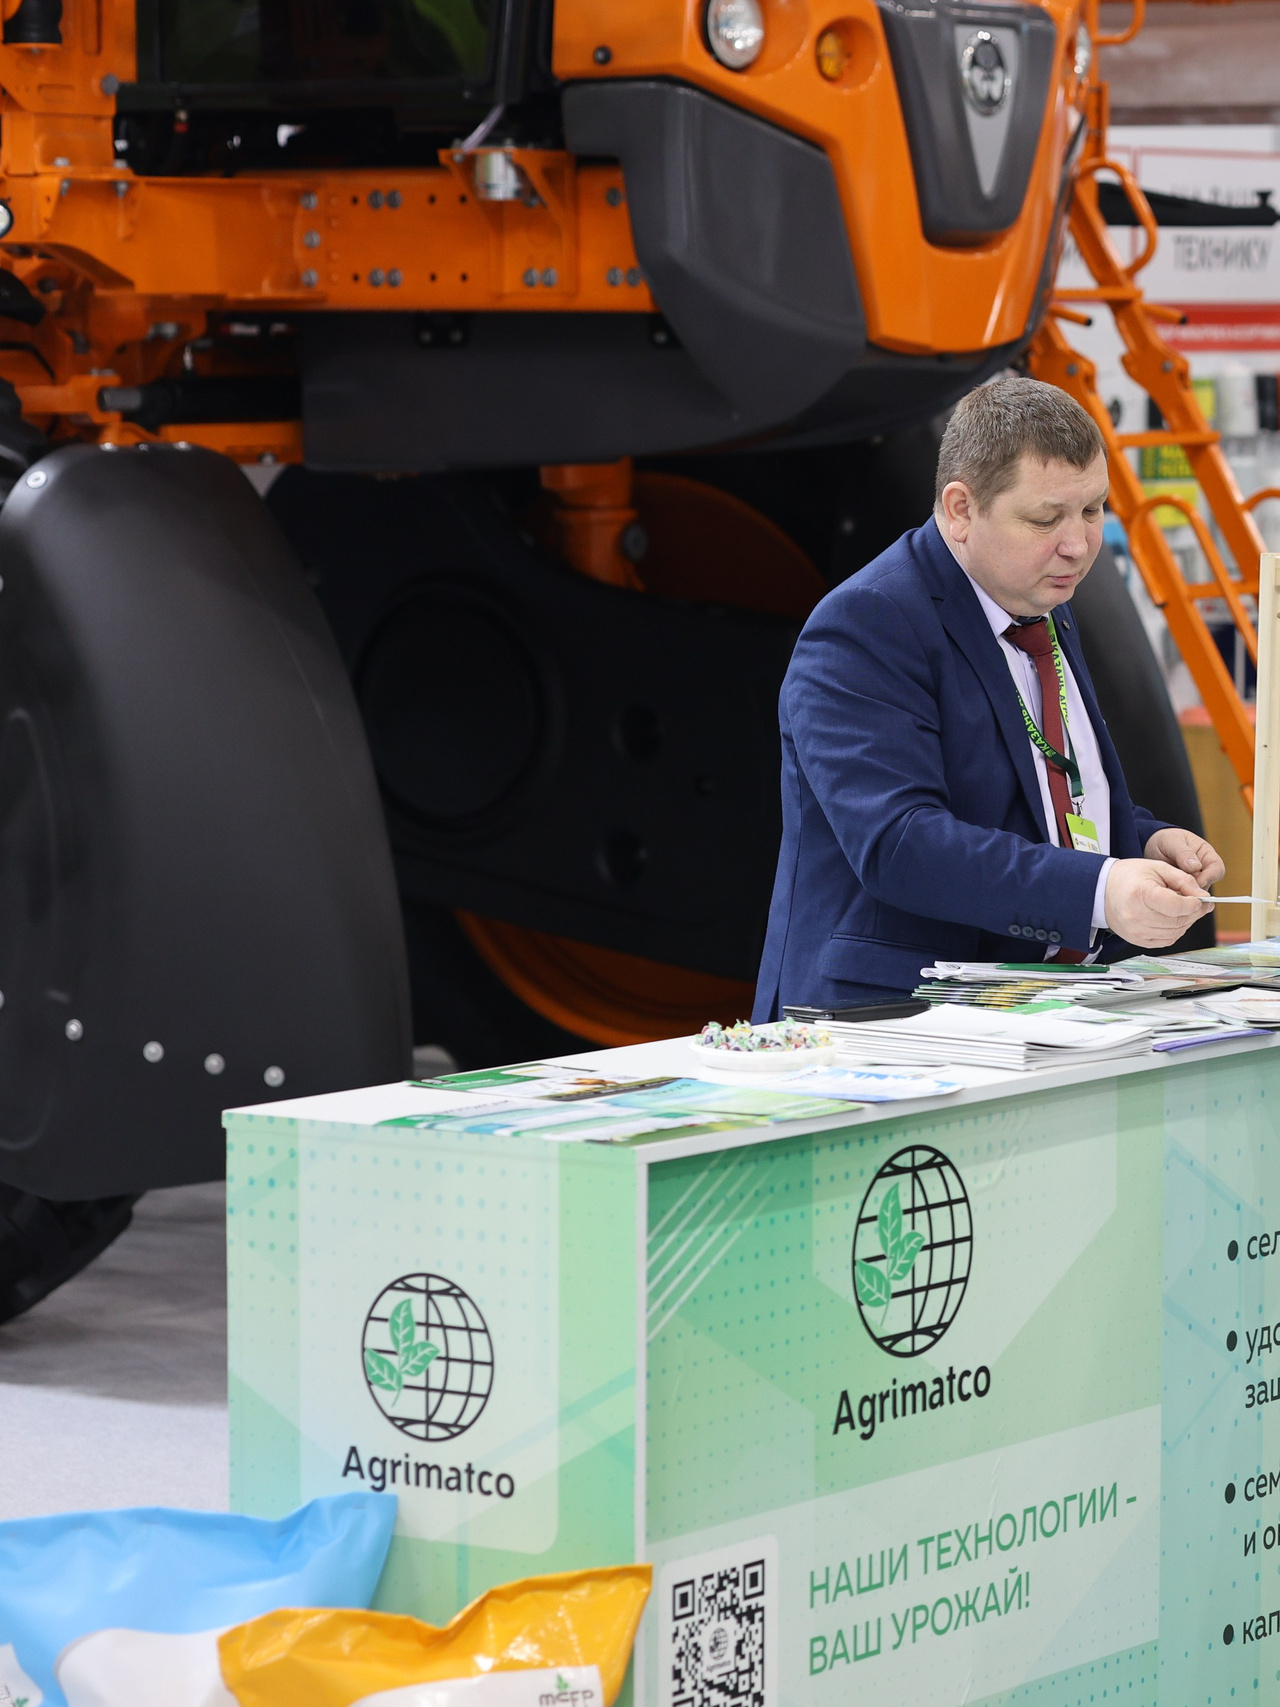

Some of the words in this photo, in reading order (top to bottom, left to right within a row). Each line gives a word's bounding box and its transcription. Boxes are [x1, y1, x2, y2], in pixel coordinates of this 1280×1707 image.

[1173, 233, 1274, 272] ТЕХНИКУ
[832, 1365, 991, 1441] Agrimatco
[342, 1446, 515, 1499] Agrimatco
[808, 1543, 909, 1609] НАШИ
[917, 1481, 1119, 1576] ТЕХНОЛОГИИ
[1245, 1531, 1256, 1557] и
[808, 1619, 883, 1677] ВАШ
[890, 1566, 1031, 1651] УРОЖАЙ!
